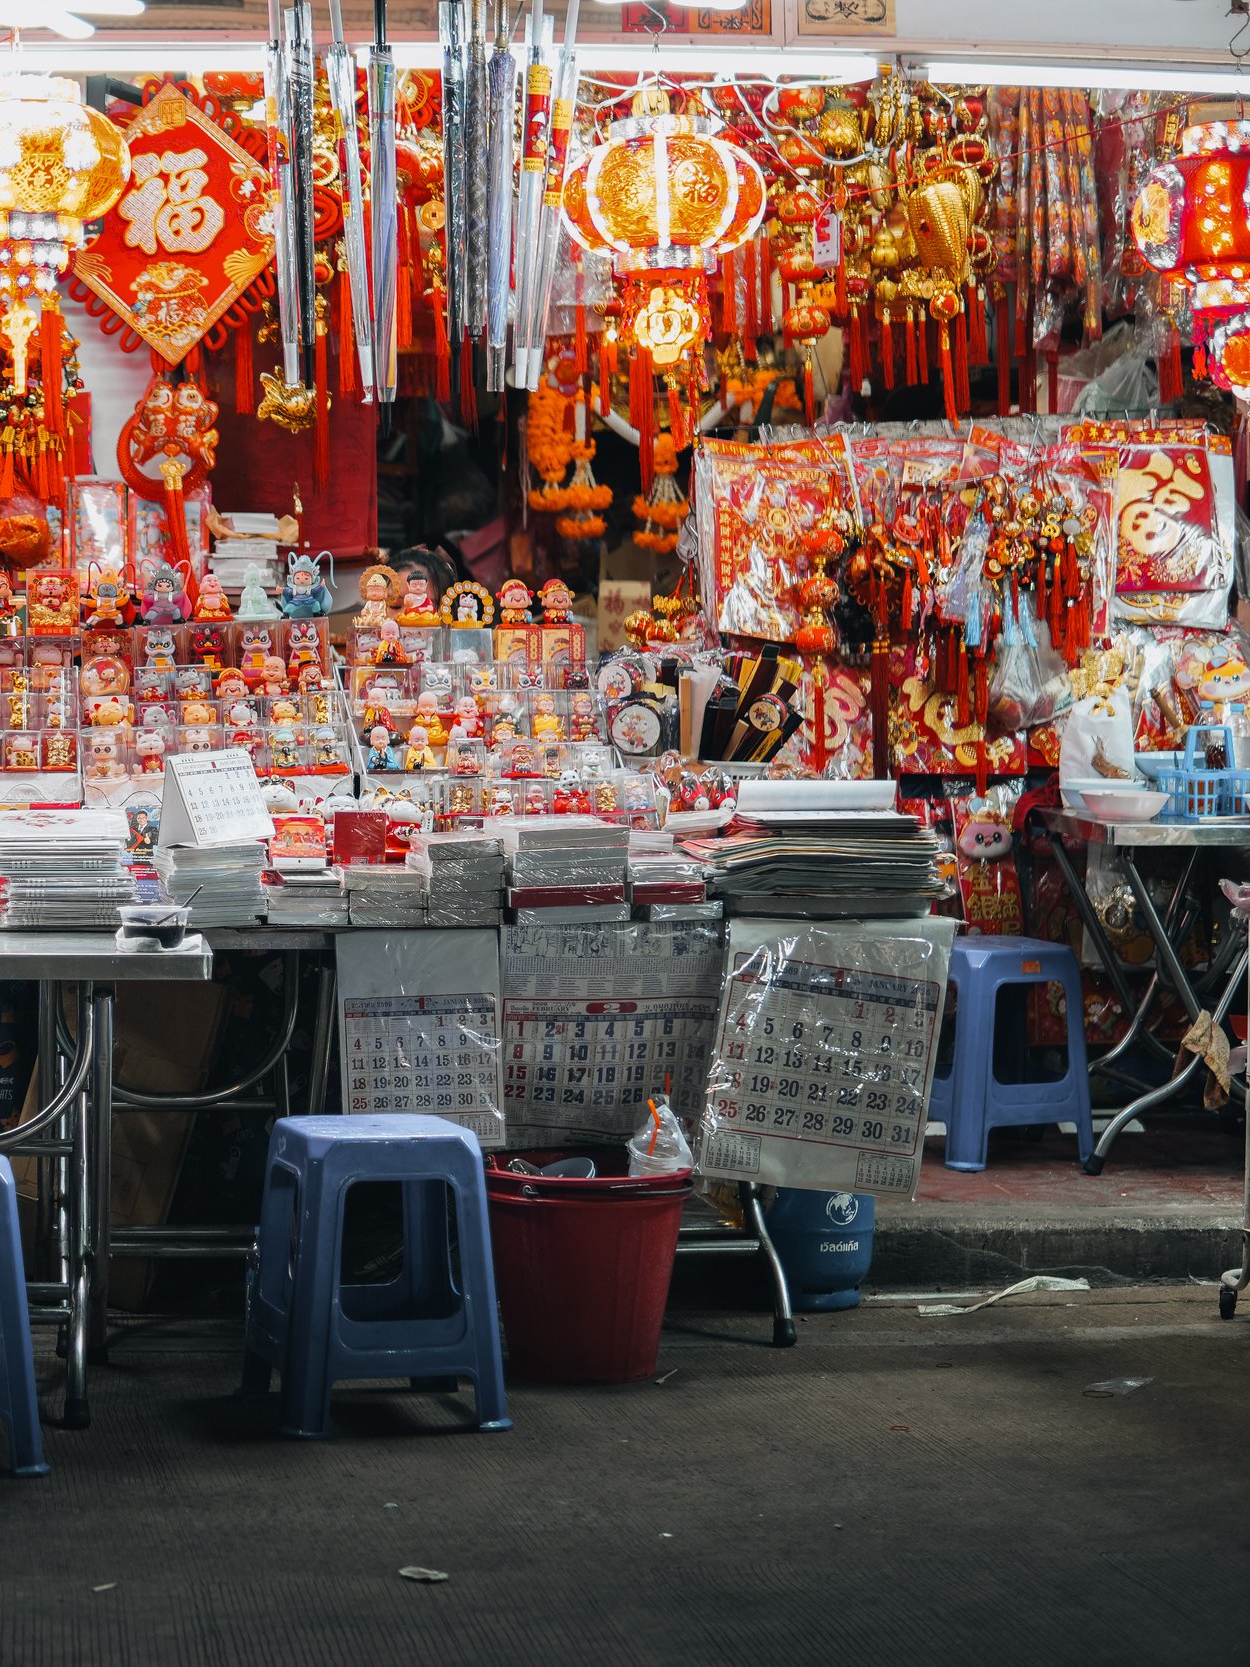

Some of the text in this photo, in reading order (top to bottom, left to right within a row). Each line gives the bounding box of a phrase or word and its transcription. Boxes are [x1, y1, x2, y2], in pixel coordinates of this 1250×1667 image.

[118, 148, 225, 256] 福
[832, 971, 844, 988] 1
[868, 978, 907, 991] JANUARY
[415, 997, 424, 1009] 1
[459, 1014, 487, 1025] 2 3
[854, 1001, 895, 1024] 1 2
[517, 1020, 673, 1037] 1 2 3 4 5 6
[736, 1014, 925, 1057] 4 5 6 7 8 9 10
[354, 1034, 466, 1049] 4 5 6 7 8 9
[513, 1042, 676, 1060] 8 9 10 11 12 13
[352, 1054, 491, 1070] 11 12 14 15 16 17
[728, 1042, 921, 1086] 11 12 13 14 15 17
[352, 1073, 493, 1089] 18 19 20 21 22 23 24
[507, 1066, 644, 1082] 15 16 17 18 19
[353, 1093, 494, 1109] 25 26 27 28 29 30 31
[504, 1084, 643, 1105] 22 23 24 25 26
[750, 1075, 916, 1115] 19 20 21 22 23 24
[718, 1100, 911, 1144] 25 26 27 28 29 30 31
